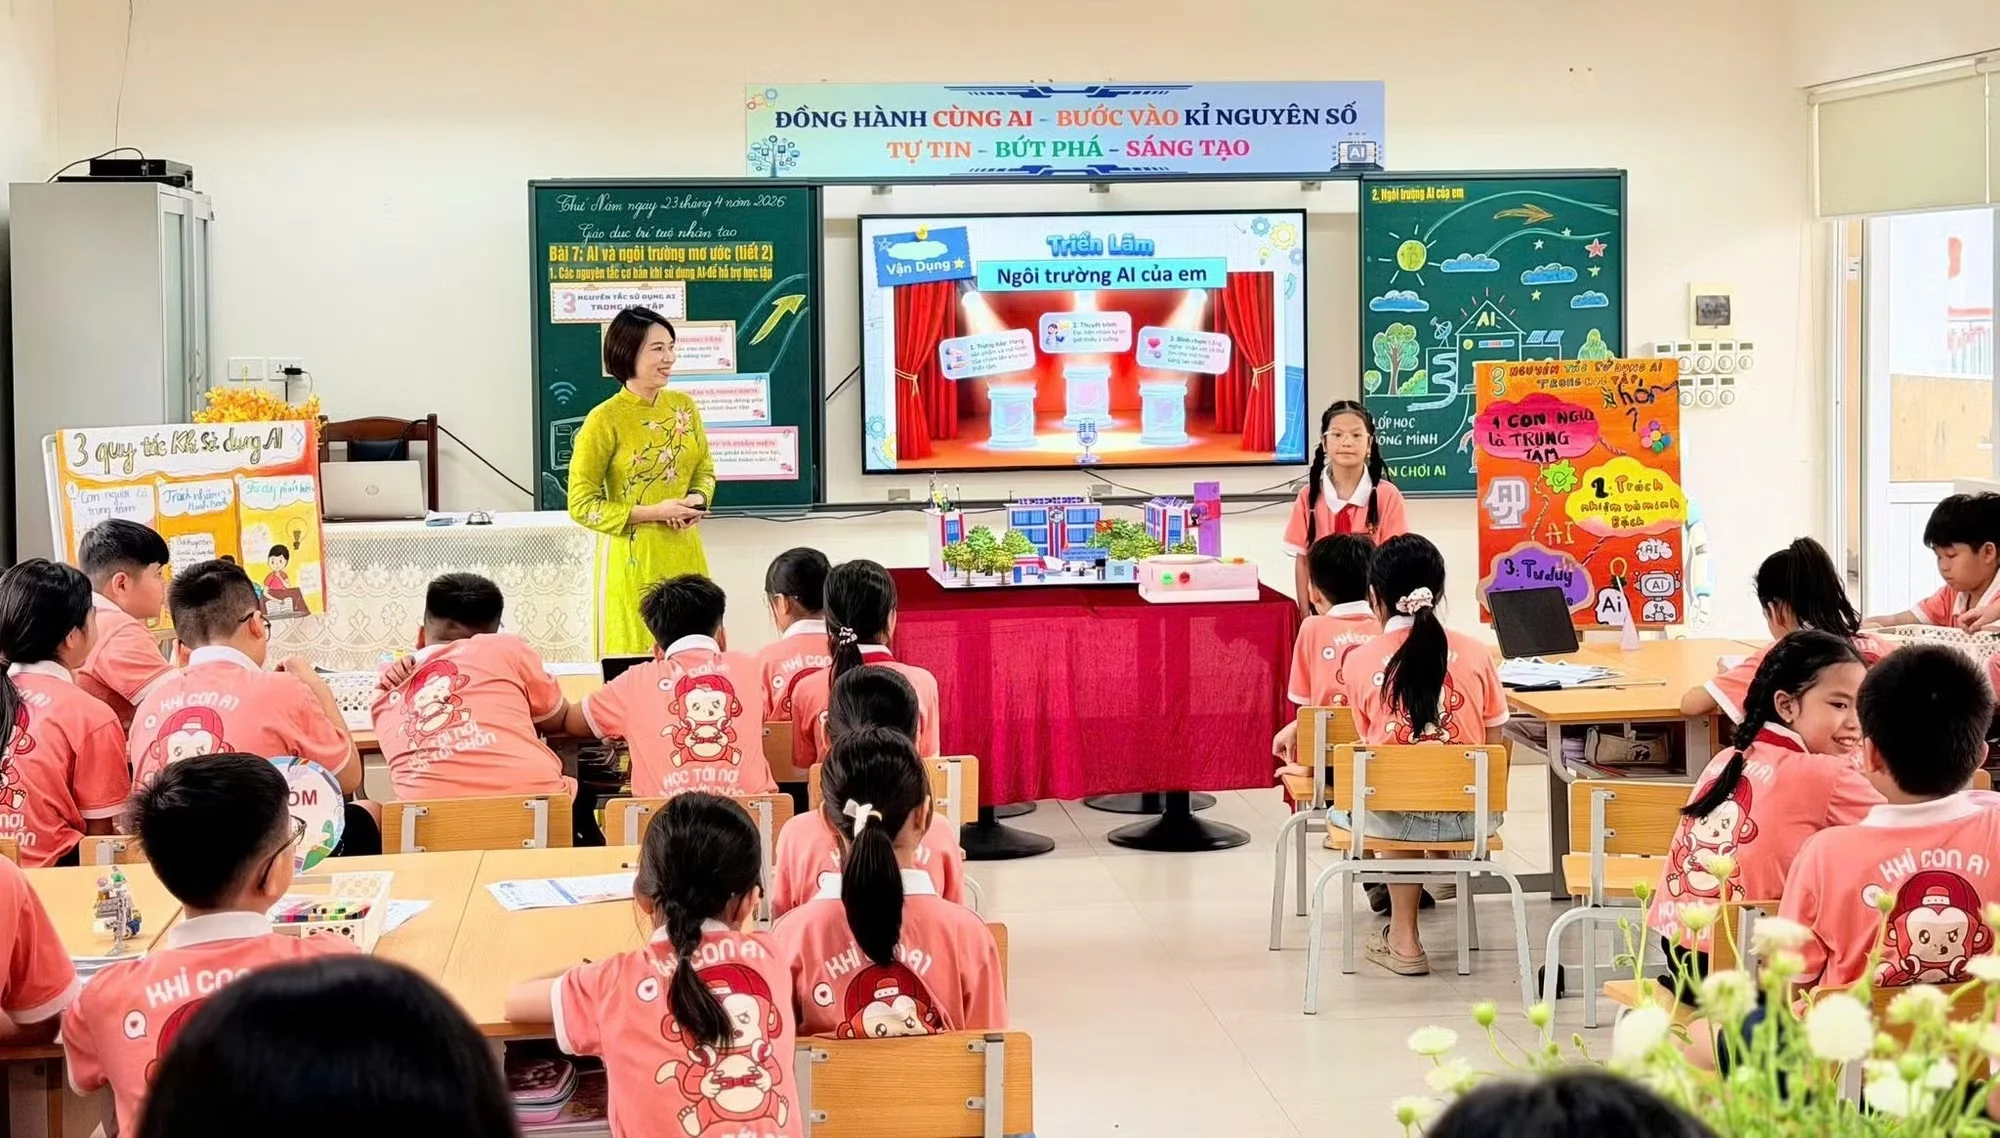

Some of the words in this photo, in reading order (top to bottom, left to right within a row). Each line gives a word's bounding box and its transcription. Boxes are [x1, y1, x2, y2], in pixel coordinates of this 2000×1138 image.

[775, 104, 847, 129] ĐỒNG
[852, 104, 927, 128] HÀNH
[932, 104, 1001, 128] CÙNG
[1006, 109, 1033, 127] AI
[1056, 104, 1124, 127] BƯỚC
[1127, 103, 1180, 127] VÀO
[1184, 103, 1210, 126] KỈ
[1215, 103, 1321, 127] NGUYÊN
[1325, 101, 1358, 125] SỐ
[886, 138, 923, 164] TỰ
[926, 141, 971, 159] TIN
[996, 135, 1046, 158] BỨT
[1052, 134, 1104, 157] PHÁ
[1126, 135, 1194, 157] SÁNG
[1198, 139, 1251, 162] TẠO
[1349, 147, 1366, 159] AI
[660, 195, 679, 209] 23
[714, 195, 724, 208] 4
[753, 194, 788, 208] 2026
[1371, 189, 1380, 201] 2.
[1381, 187, 1399, 202] Ngôi
[1400, 187, 1425, 201] trường
[1426, 187, 1435, 199] AI
[1436, 185, 1450, 201] của
[1451, 188, 1464, 199] em
[678, 220, 713, 239] nhân
[716, 225, 738, 240] tạo
[549, 245, 569, 262] Bài
[571, 246, 584, 262] 7:
[586, 246, 600, 262] AI
[601, 245, 616, 261] và
[619, 245, 645, 263] ngôi
[648, 245, 685, 263] trường
[688, 246, 707, 261] mơ
[710, 245, 731, 261] ước
[735, 241, 758, 262] (tiết
[761, 244, 773, 262] 2)
[1046, 231, 1103, 257] Triển
[1108, 233, 1155, 256] Lãm
[549, 267, 557, 279] 1.
[559, 266, 574, 279] Các
[576, 266, 605, 281] nguyên
[606, 264, 620, 279] tắc
[621, 267, 632, 279] cơ
[633, 265, 648, 279] bản
[650, 267, 663, 279] khi
[664, 265, 674, 279] sử
[675, 267, 695, 281] dụng
[697, 266, 706, 278] AI
[744, 267, 758, 281] học
[760, 265, 773, 281] tập
[886, 262, 912, 276] Vận
[915, 259, 951, 273] Dụng
[997, 267, 1039, 287] Ngôi
[1046, 267, 1112, 286] trường
[1116, 267, 1135, 282] AI
[1141, 264, 1173, 282] của
[1178, 268, 1208, 282] em
[563, 292, 577, 314] 3
[591, 303, 623, 311] TRONG
[1476, 311, 1496, 327] AI
[1510, 363, 1560, 377] NGUYÊN
[1595, 359, 1614, 374] SỬ
[1492, 367, 1506, 398] 3
[1537, 378, 1581, 390] TRONG
[1393, 418, 1416, 432] HỌC
[1507, 413, 1547, 429] CON
[1488, 432, 1506, 447] là
[1509, 432, 1570, 447] TRUNG
[72, 433, 89, 467] 3
[95, 441, 137, 475] quy
[171, 429, 199, 455] Khi
[263, 427, 283, 450] AI
[1523, 446, 1560, 463] TÂM
[1400, 463, 1430, 477] CHƠI
[1434, 465, 1446, 476] AI
[1615, 475, 1664, 494] Trách
[80, 491, 100, 504] Con
[1498, 484, 1522, 503] AI
[1580, 500, 1622, 515] nhiệm
[1642, 498, 1681, 511] minh
[1610, 515, 1645, 529] Bạch
[1545, 521, 1575, 545] AI
[1645, 545, 1660, 554] AI
[1504, 558, 1520, 577] 3:
[1652, 582, 1665, 590] AI
[1602, 596, 1622, 613] Ai
[1921, 848, 1963, 870] CON
[1966, 853, 1990, 879] AI
[690, 938, 736, 971] CON
[907, 948, 933, 976] AI
